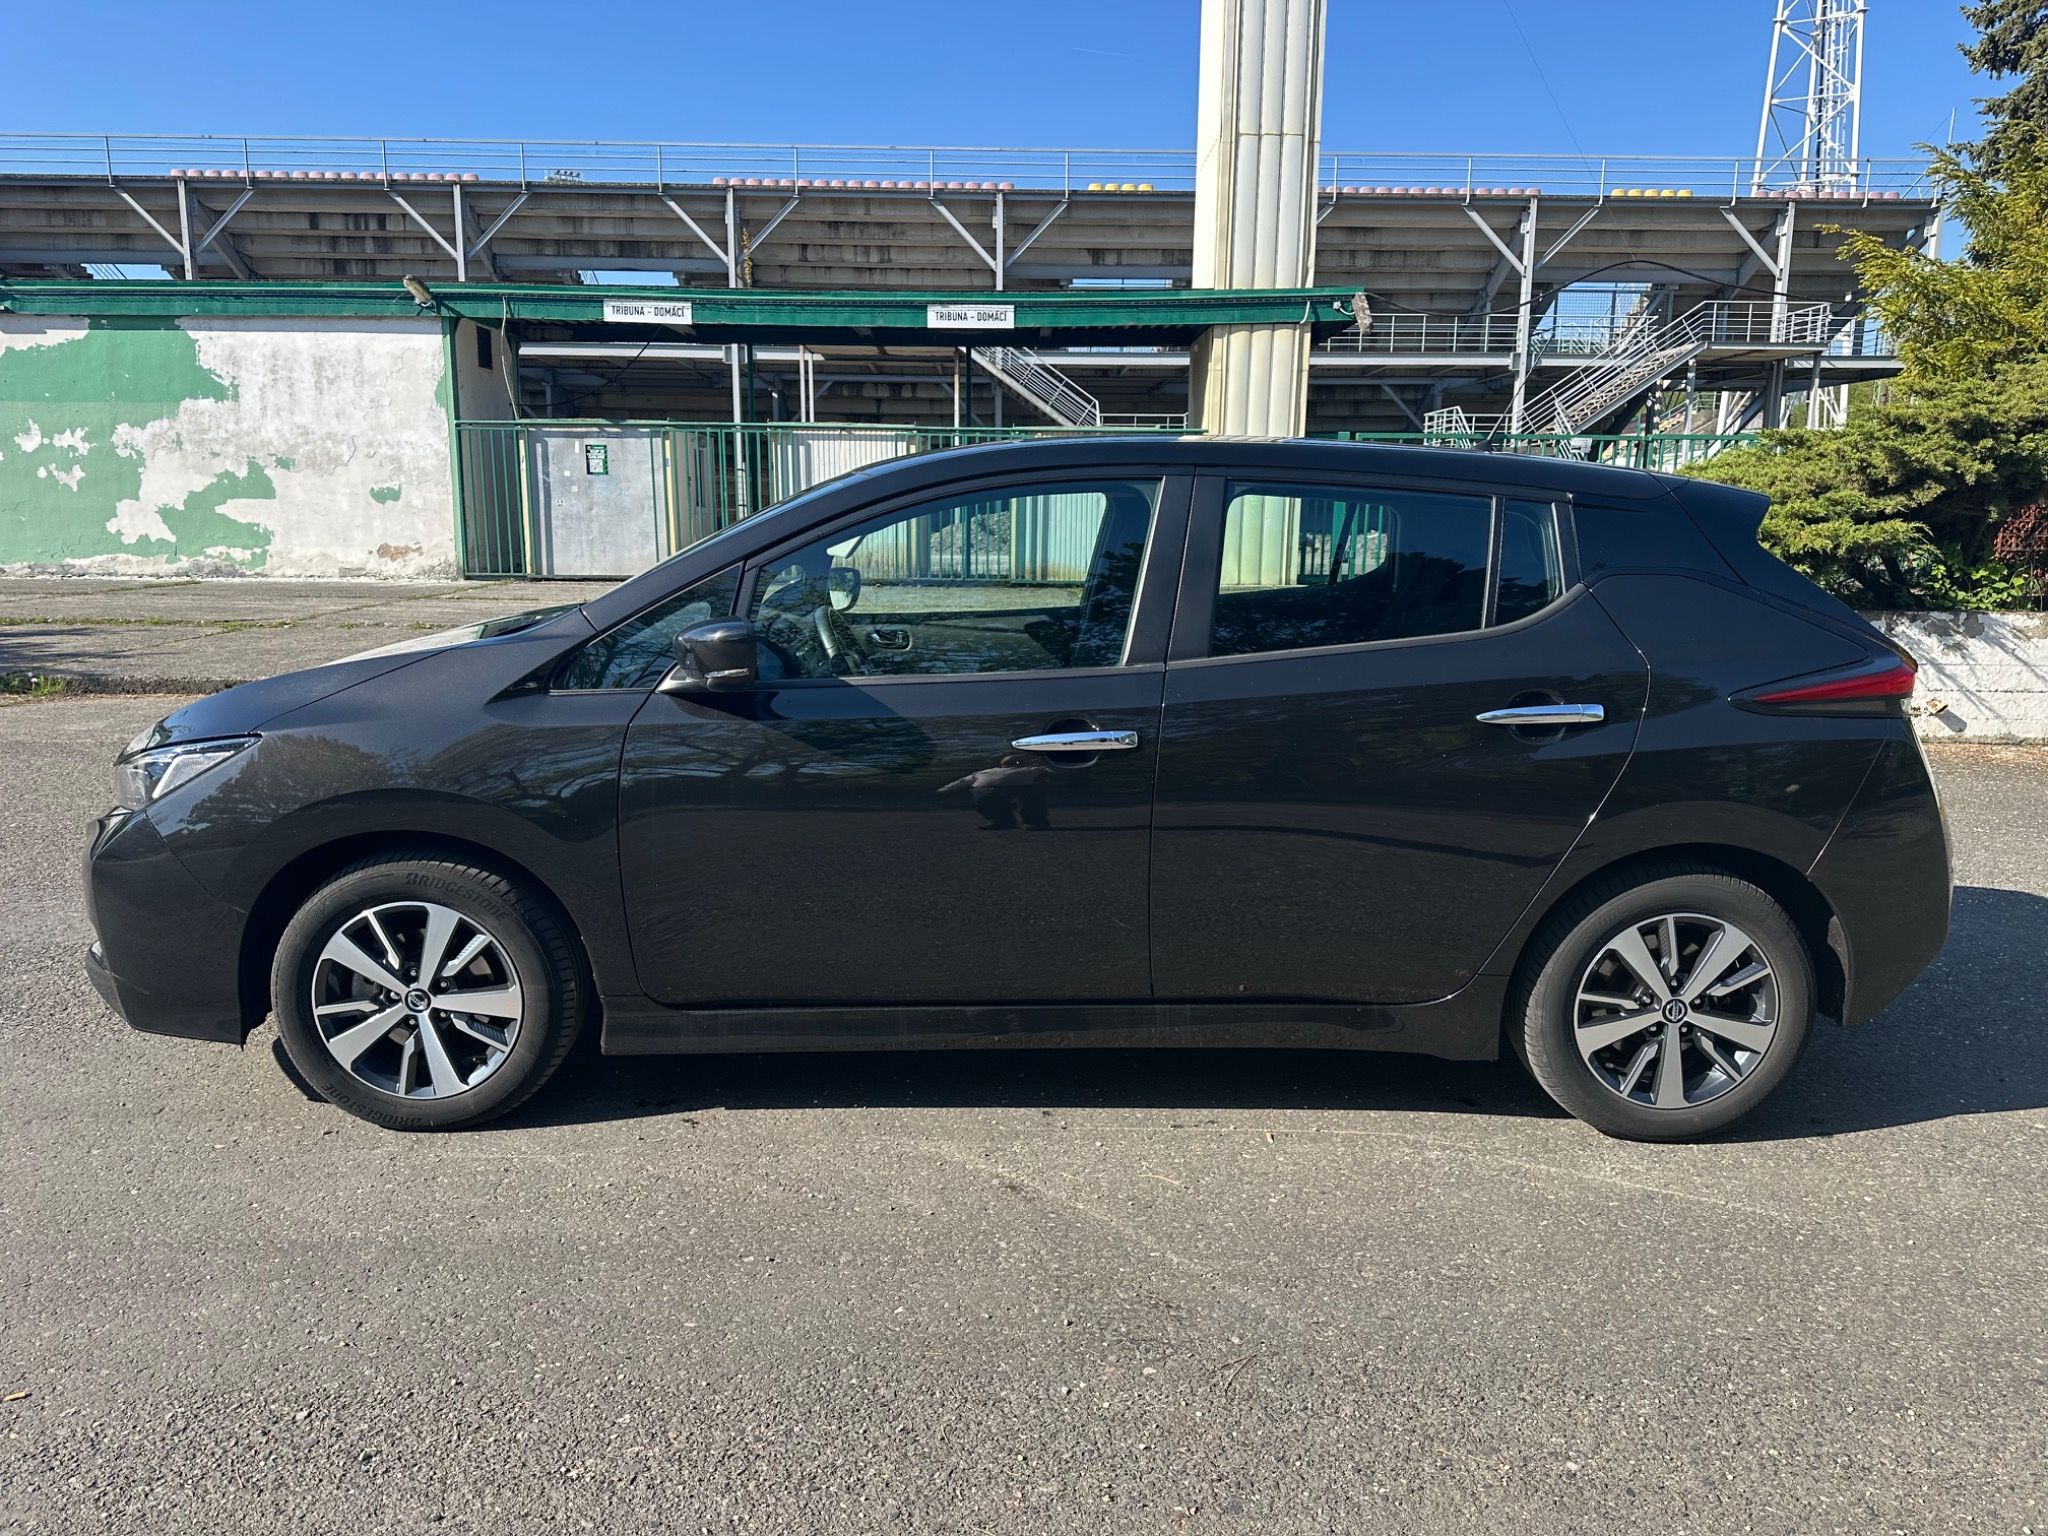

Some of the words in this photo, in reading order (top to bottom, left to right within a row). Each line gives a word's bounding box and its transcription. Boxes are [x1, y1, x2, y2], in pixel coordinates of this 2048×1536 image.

[611, 305, 645, 316] TRIBUNA
[653, 305, 685, 317] DOMÁCÍ
[935, 311, 968, 321] TRIBUNA
[404, 872, 509, 920] BRIDGESTONE
[321, 1082, 422, 1125] BRIDGESTONE
